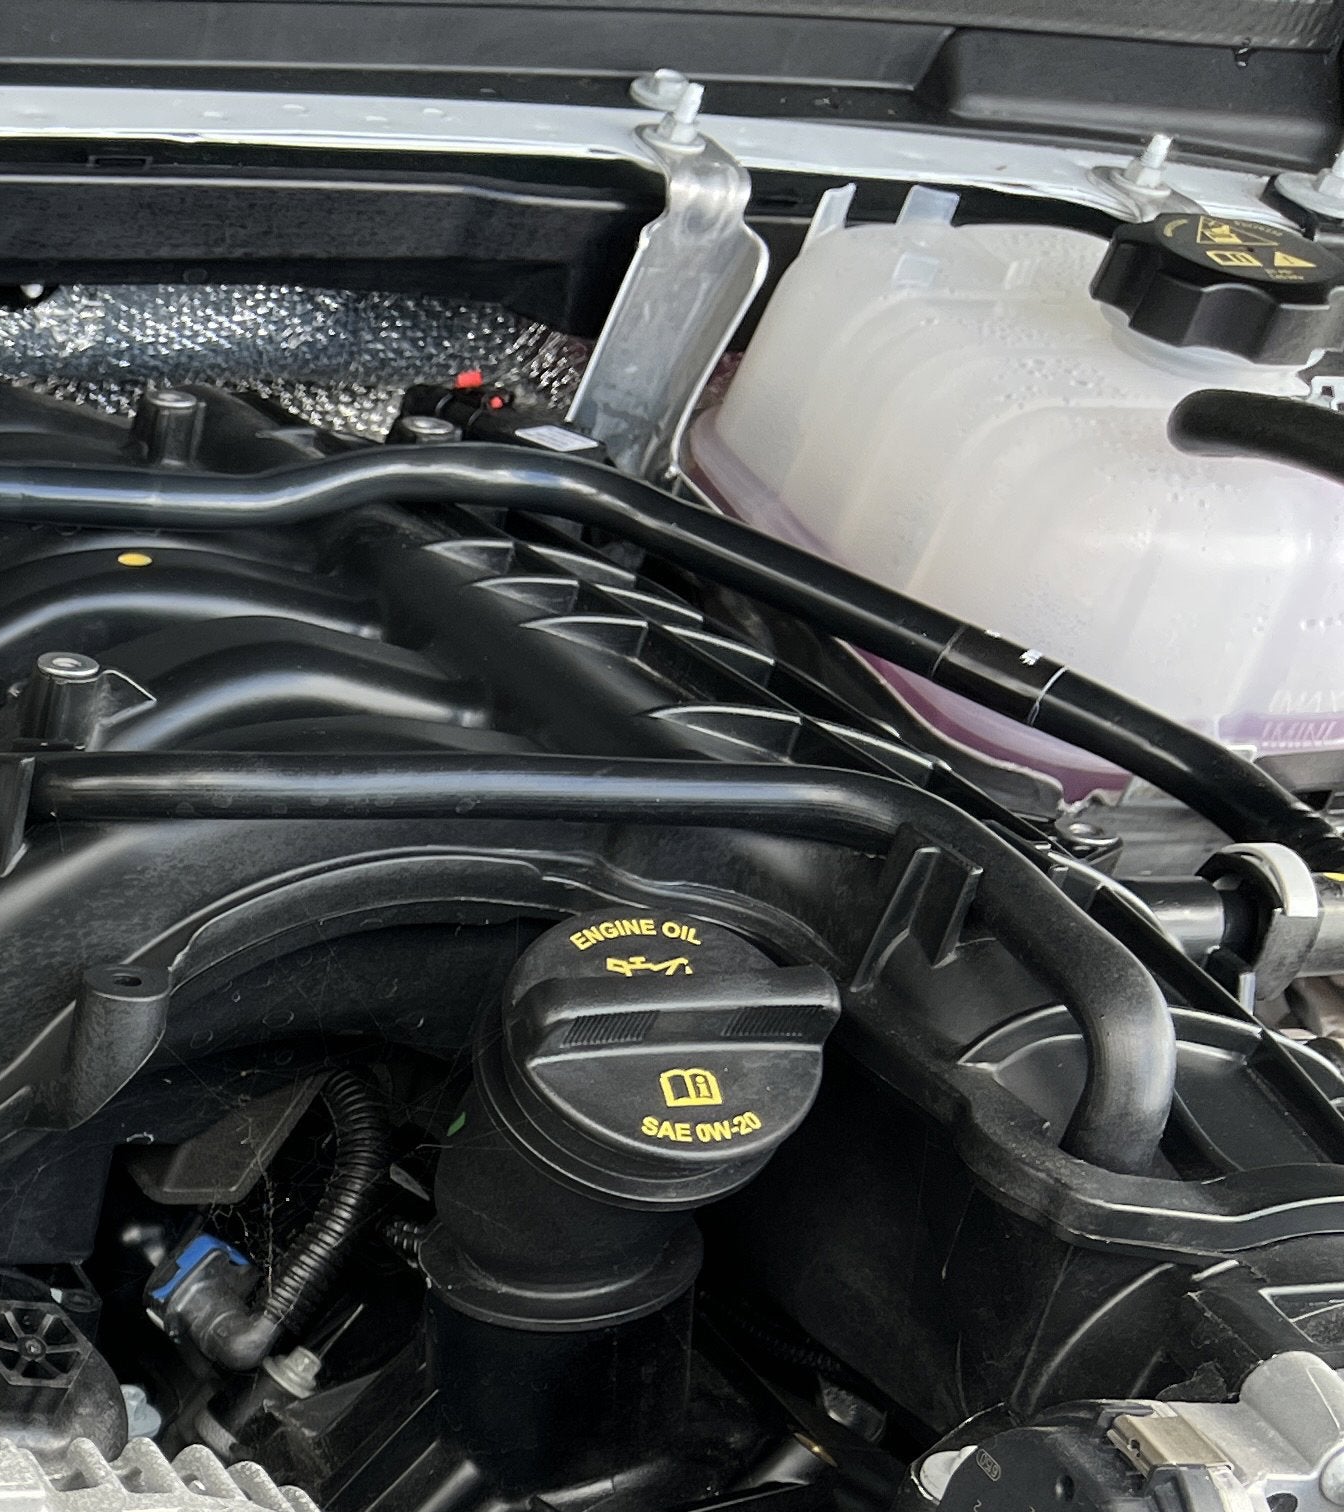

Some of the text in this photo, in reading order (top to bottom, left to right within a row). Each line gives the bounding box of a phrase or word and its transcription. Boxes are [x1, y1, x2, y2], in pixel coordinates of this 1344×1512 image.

[569, 919, 702, 951] ENGINE OIL
[641, 1111, 762, 1143] SAE 0W-20
